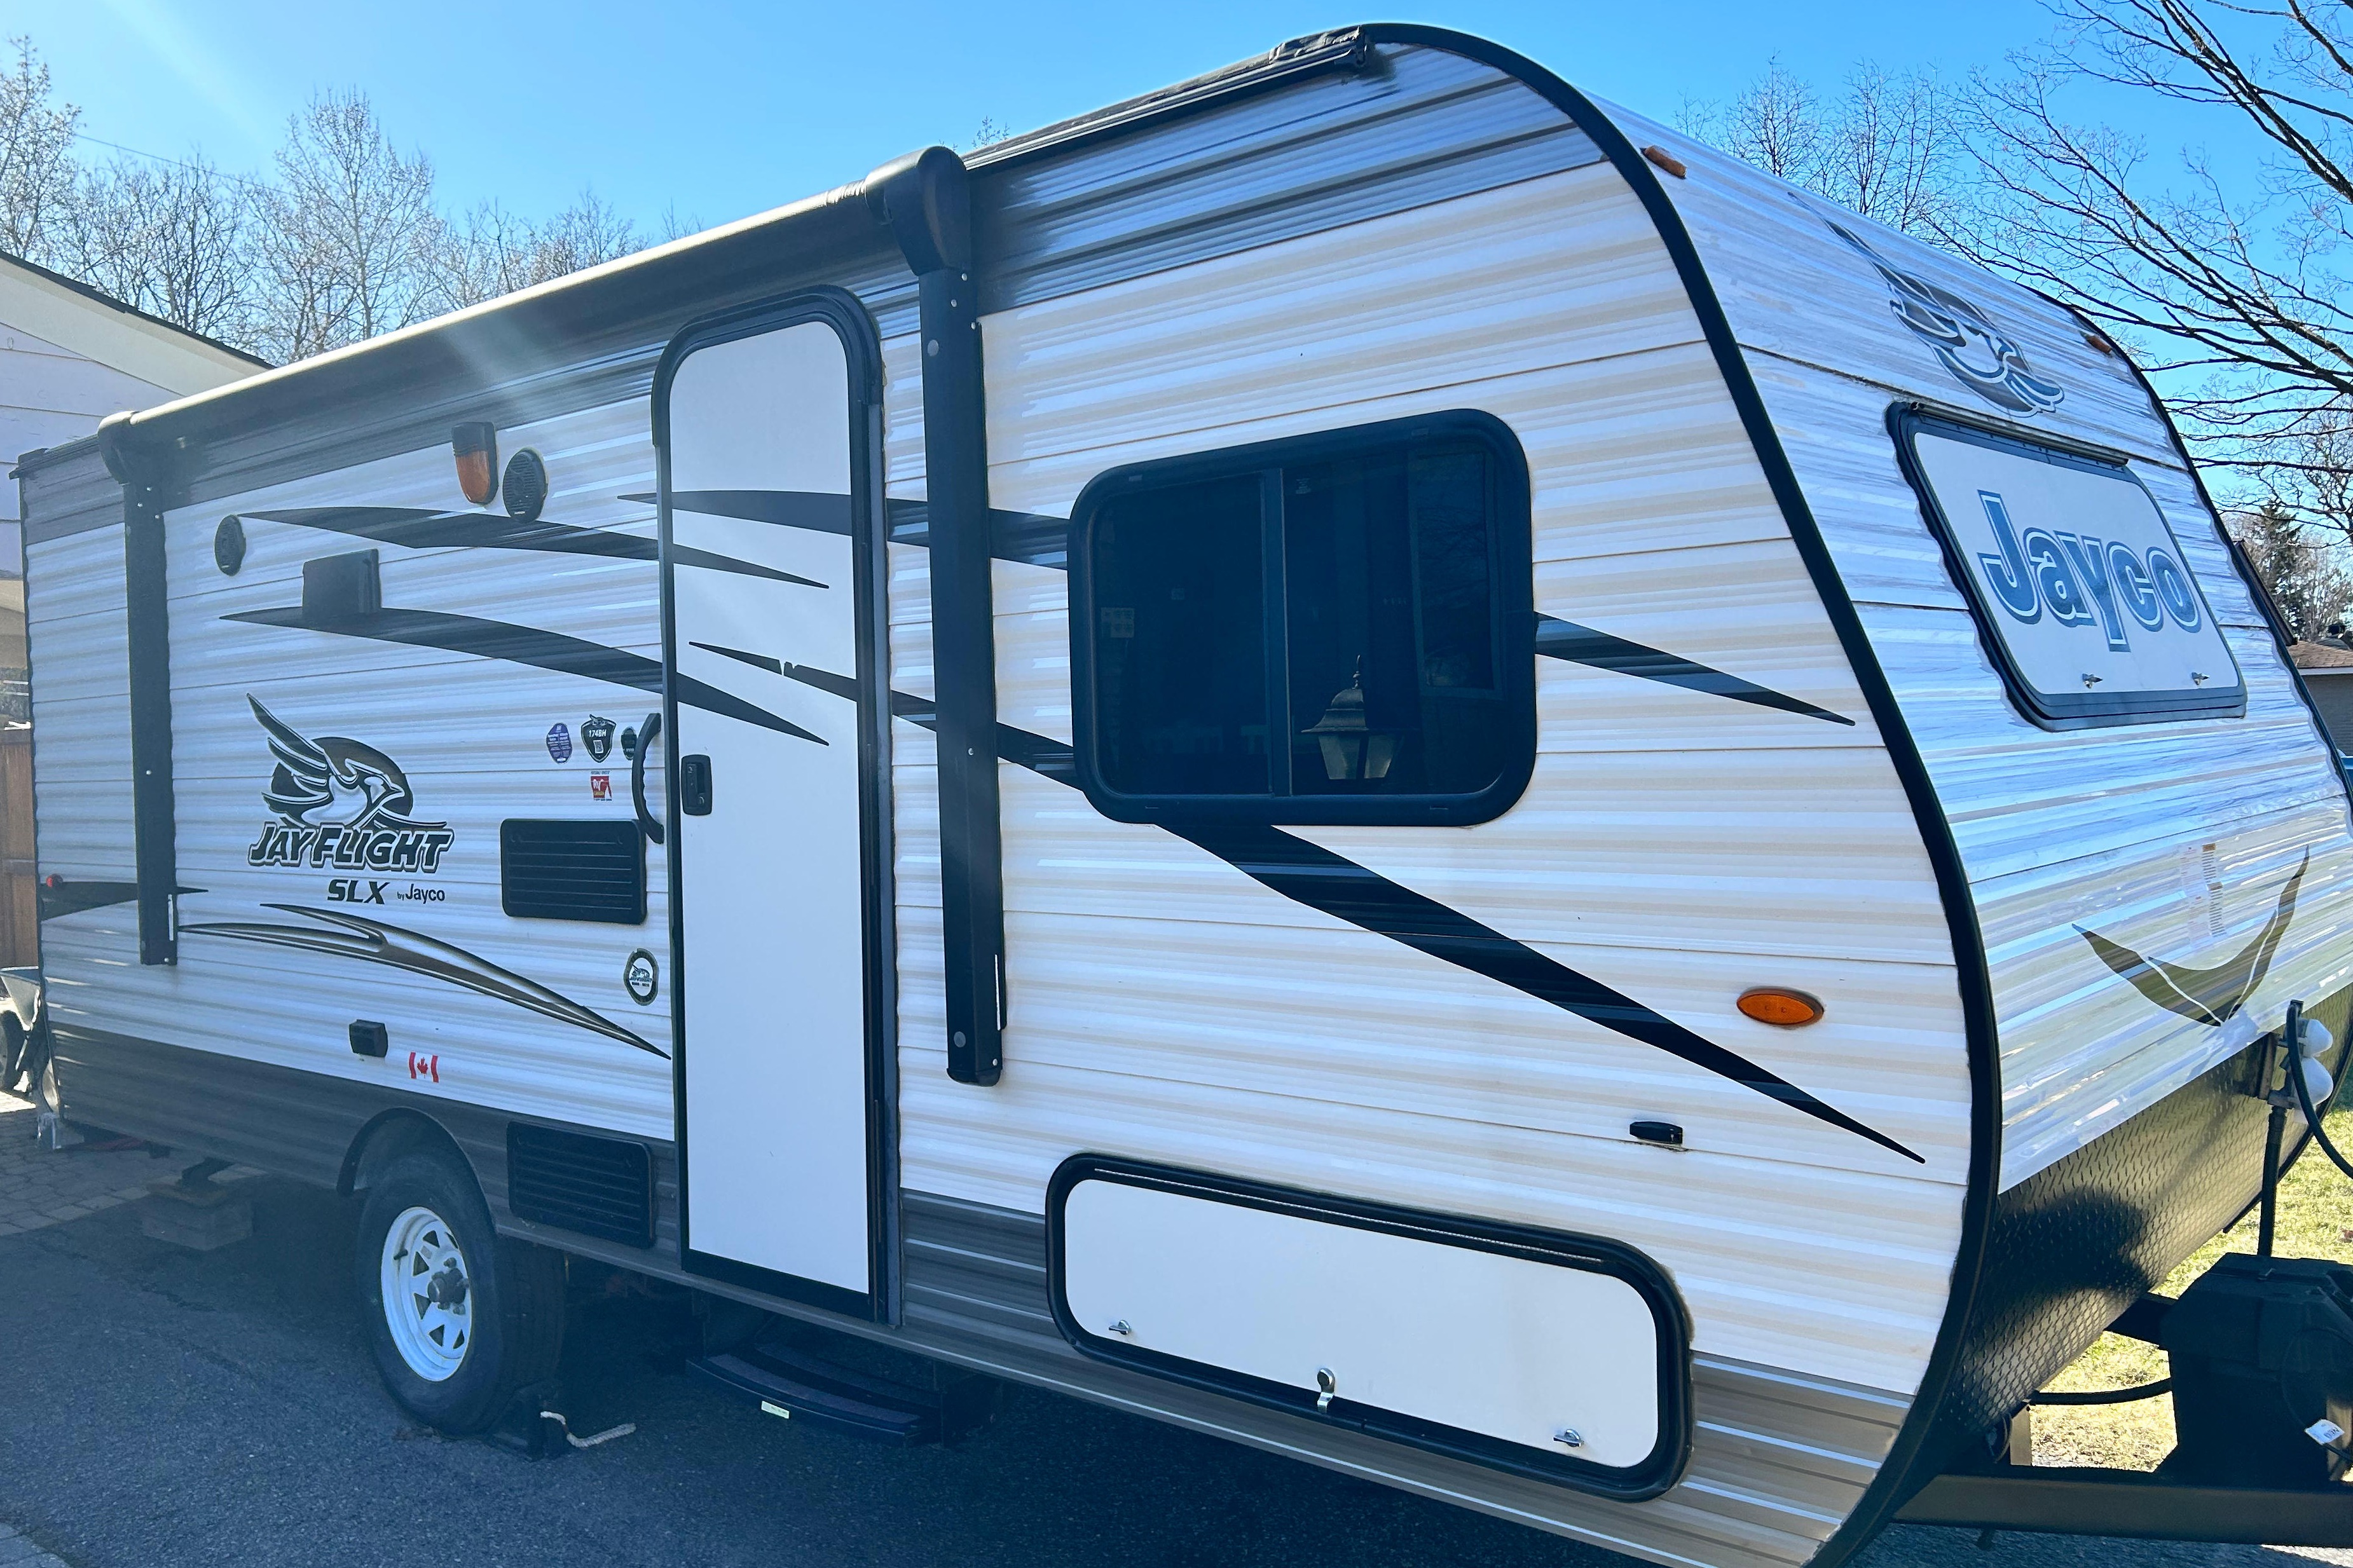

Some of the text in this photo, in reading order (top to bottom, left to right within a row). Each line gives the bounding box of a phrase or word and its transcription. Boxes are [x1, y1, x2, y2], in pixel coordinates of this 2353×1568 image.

[1977, 489, 2202, 652] Jayco
[327, 880, 446, 904] SLX by Jayco
